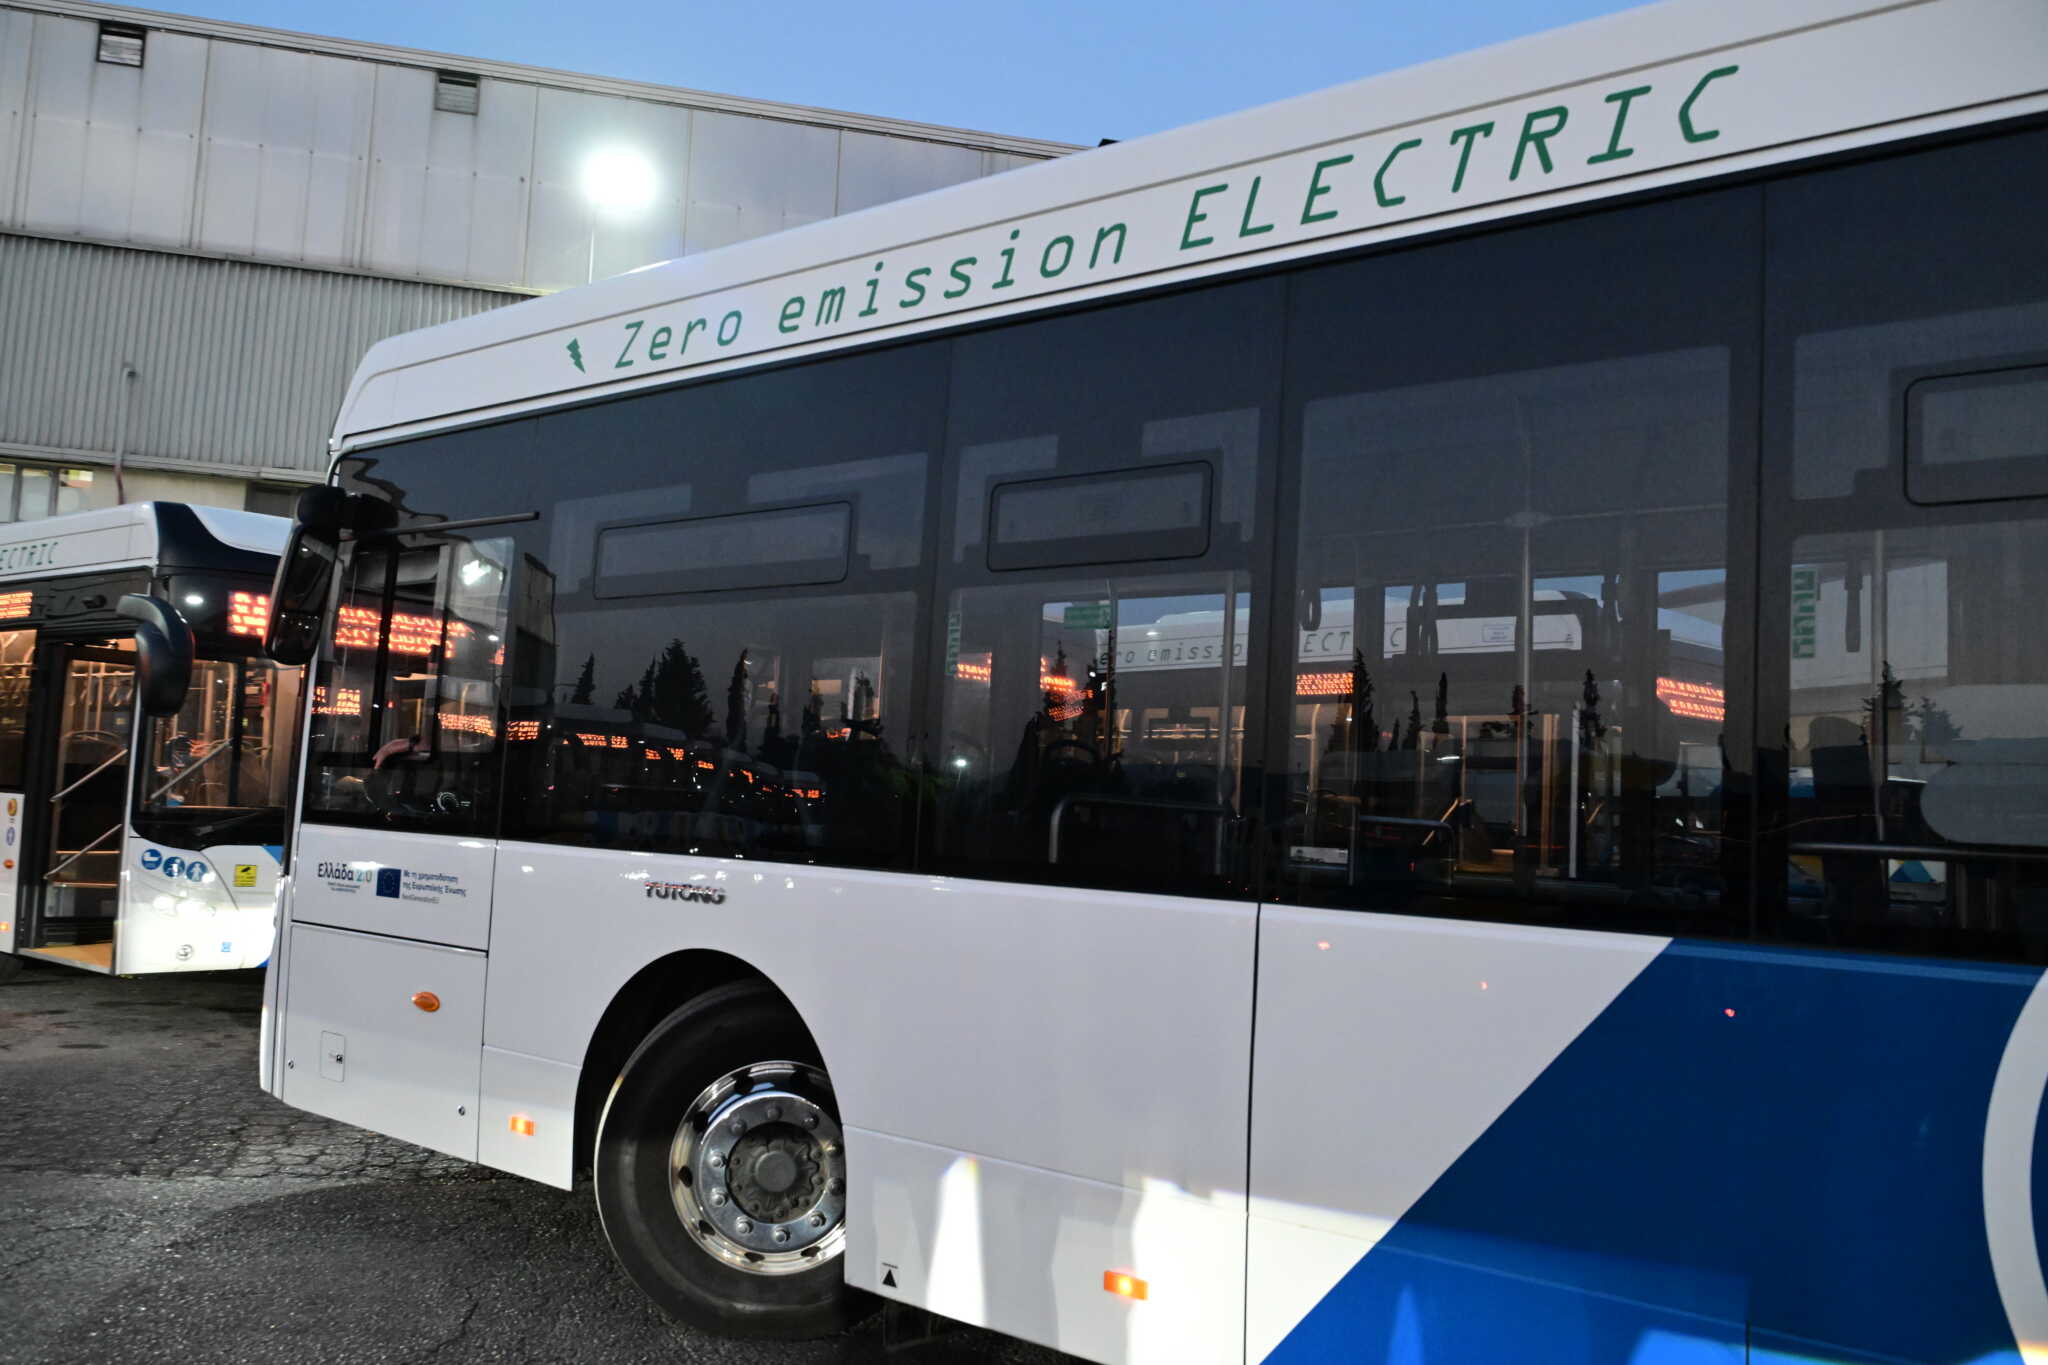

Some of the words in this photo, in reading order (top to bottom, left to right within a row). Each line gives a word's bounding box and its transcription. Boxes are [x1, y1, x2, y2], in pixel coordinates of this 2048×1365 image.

[614, 309, 743, 369] Zero
[778, 222, 1128, 333] emission
[1180, 64, 1739, 250] ELECTRIC
[317, 861, 354, 881] Ελλάδα
[644, 880, 727, 905] YUTONG
